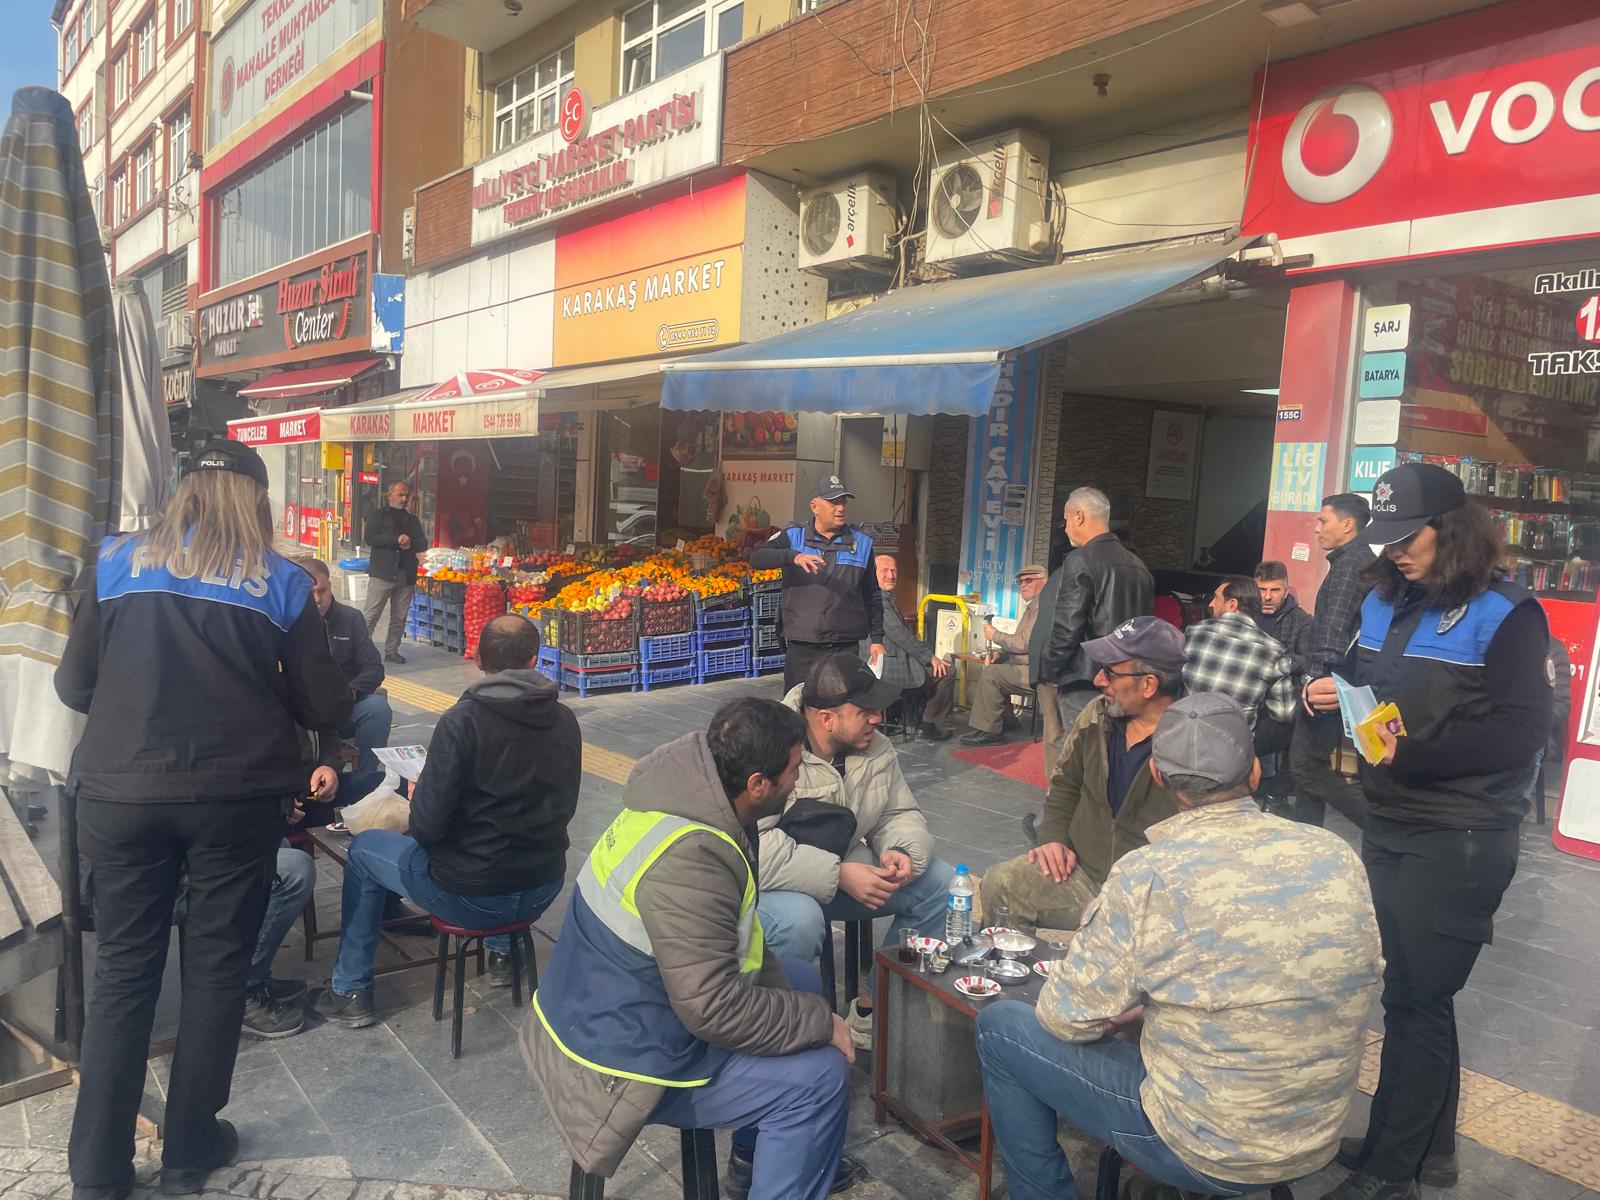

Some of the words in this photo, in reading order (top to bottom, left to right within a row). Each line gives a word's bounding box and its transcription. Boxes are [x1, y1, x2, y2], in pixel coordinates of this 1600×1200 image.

[237, 35, 278, 91] MAHALLE
[264, 40, 305, 101] DERNEĞİ
[545, 124, 620, 182] HAREKET
[624, 90, 698, 149] PARTİSİ
[990, 139, 1006, 198] arçelik
[847, 182, 858, 232] arçelik
[276, 276, 318, 315] Huzur
[319, 254, 360, 305] Simit
[562, 279, 638, 319] KARAKAŞ
[644, 260, 726, 304] MARKET
[207, 298, 246, 341] HUZUR
[295, 307, 335, 343] Center
[1373, 319, 1402, 338] ŞARJ
[215, 338, 237, 357] MARKET
[1363, 368, 1400, 382] BATARYA
[236, 425, 268, 443] TUNCELLER
[279, 418, 307, 438] MARKET
[350, 413, 390, 436] KARAKAŞ
[412, 409, 456, 434] MARKET
[1278, 411, 1300, 420] 155C
[760, 472, 794, 484] MARKET
